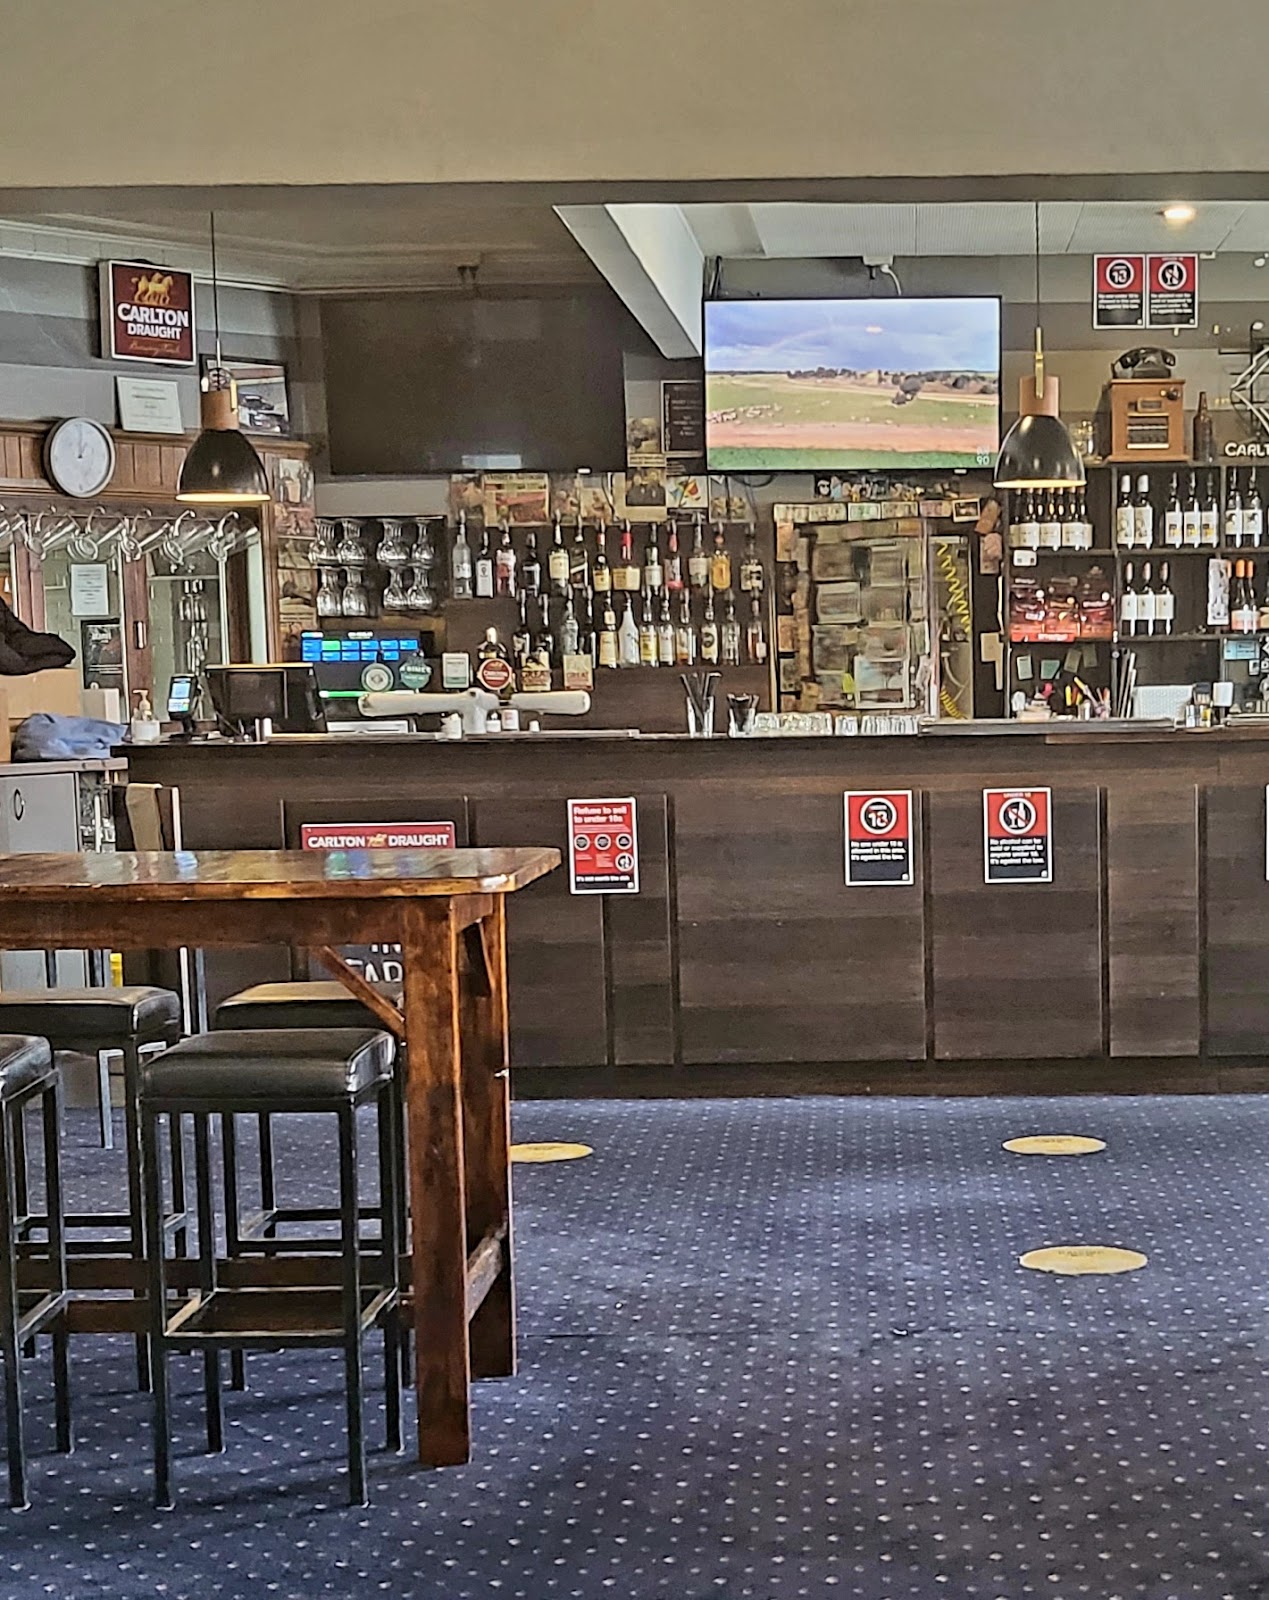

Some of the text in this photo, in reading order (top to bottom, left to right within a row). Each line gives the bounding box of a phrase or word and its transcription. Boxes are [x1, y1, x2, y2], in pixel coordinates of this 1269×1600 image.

[117, 303, 189, 328] CARLTON
[127, 323, 182, 340] DRAUGHT
[574, 805, 627, 815] Refuse to sell
[574, 816, 583, 824] to
[308, 835, 449, 848] CARLTON DRAUGHT
